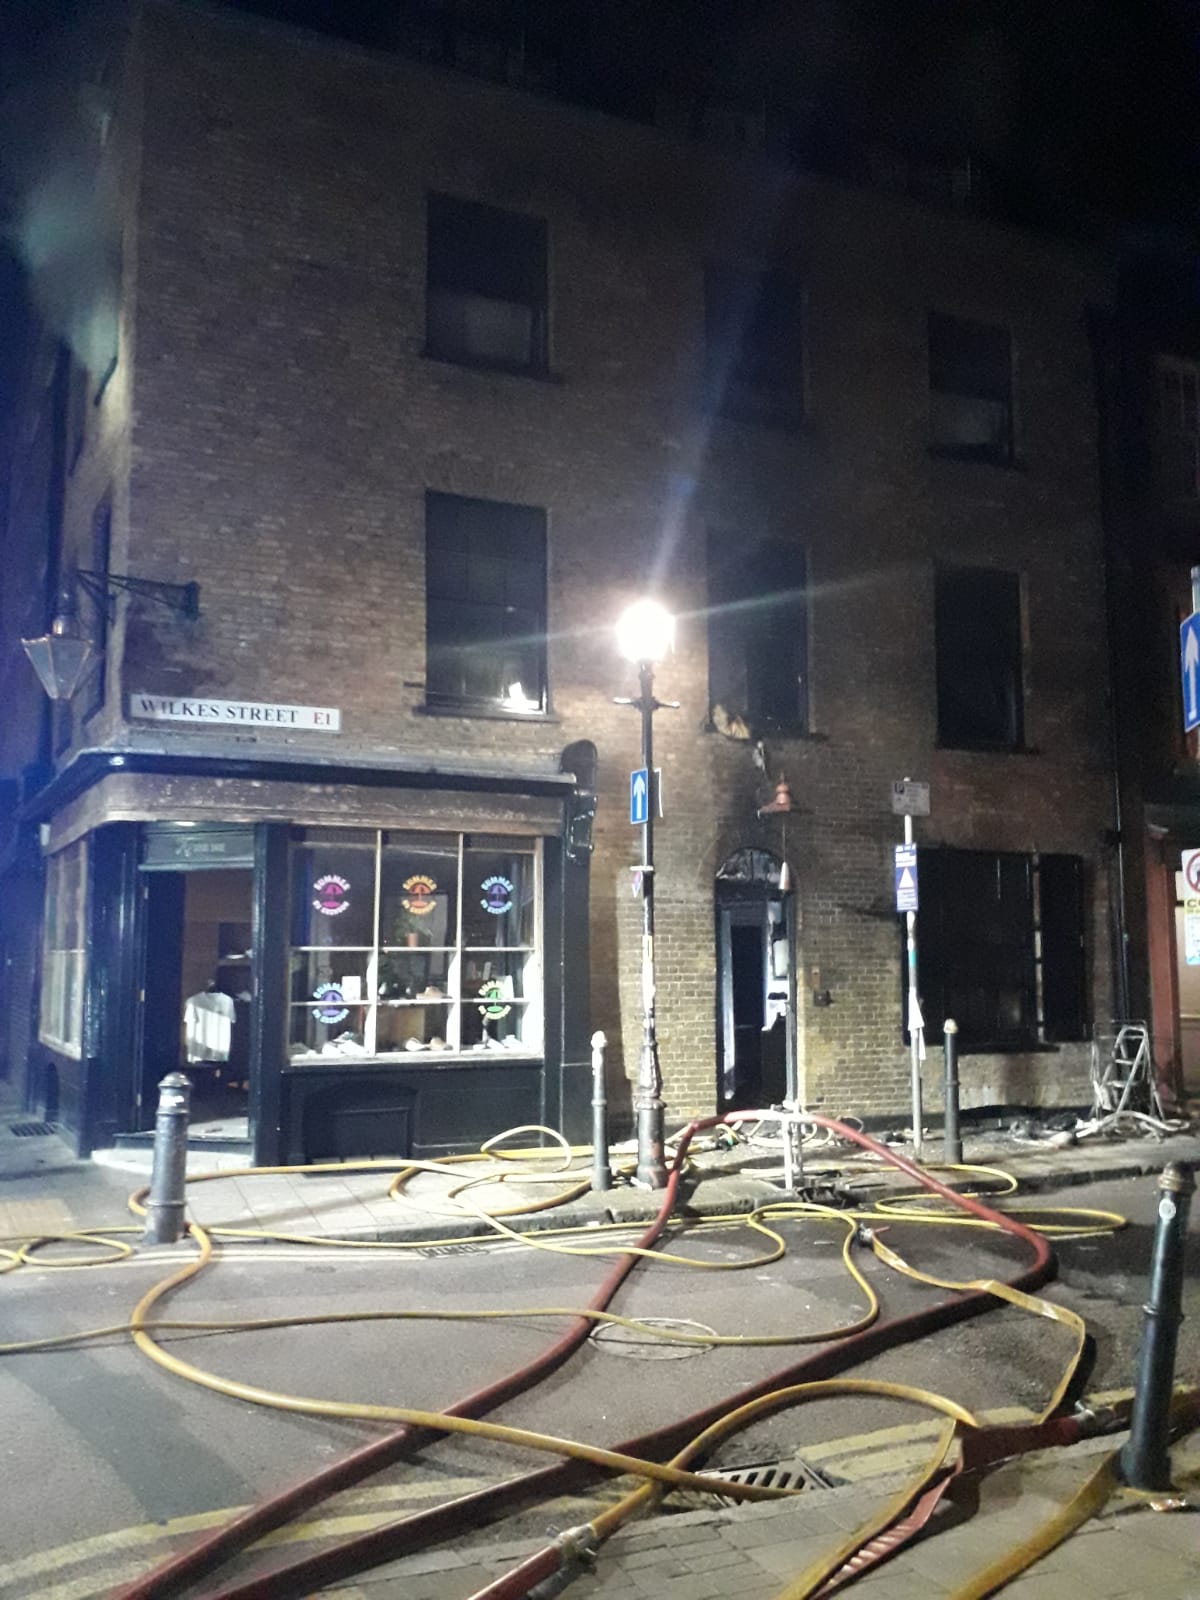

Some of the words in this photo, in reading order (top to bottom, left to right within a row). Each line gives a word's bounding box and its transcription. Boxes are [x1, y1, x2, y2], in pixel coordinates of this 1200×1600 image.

[139, 699, 220, 718] WILKES
[226, 705, 299, 724] STREET
[313, 711, 331, 726] E1
